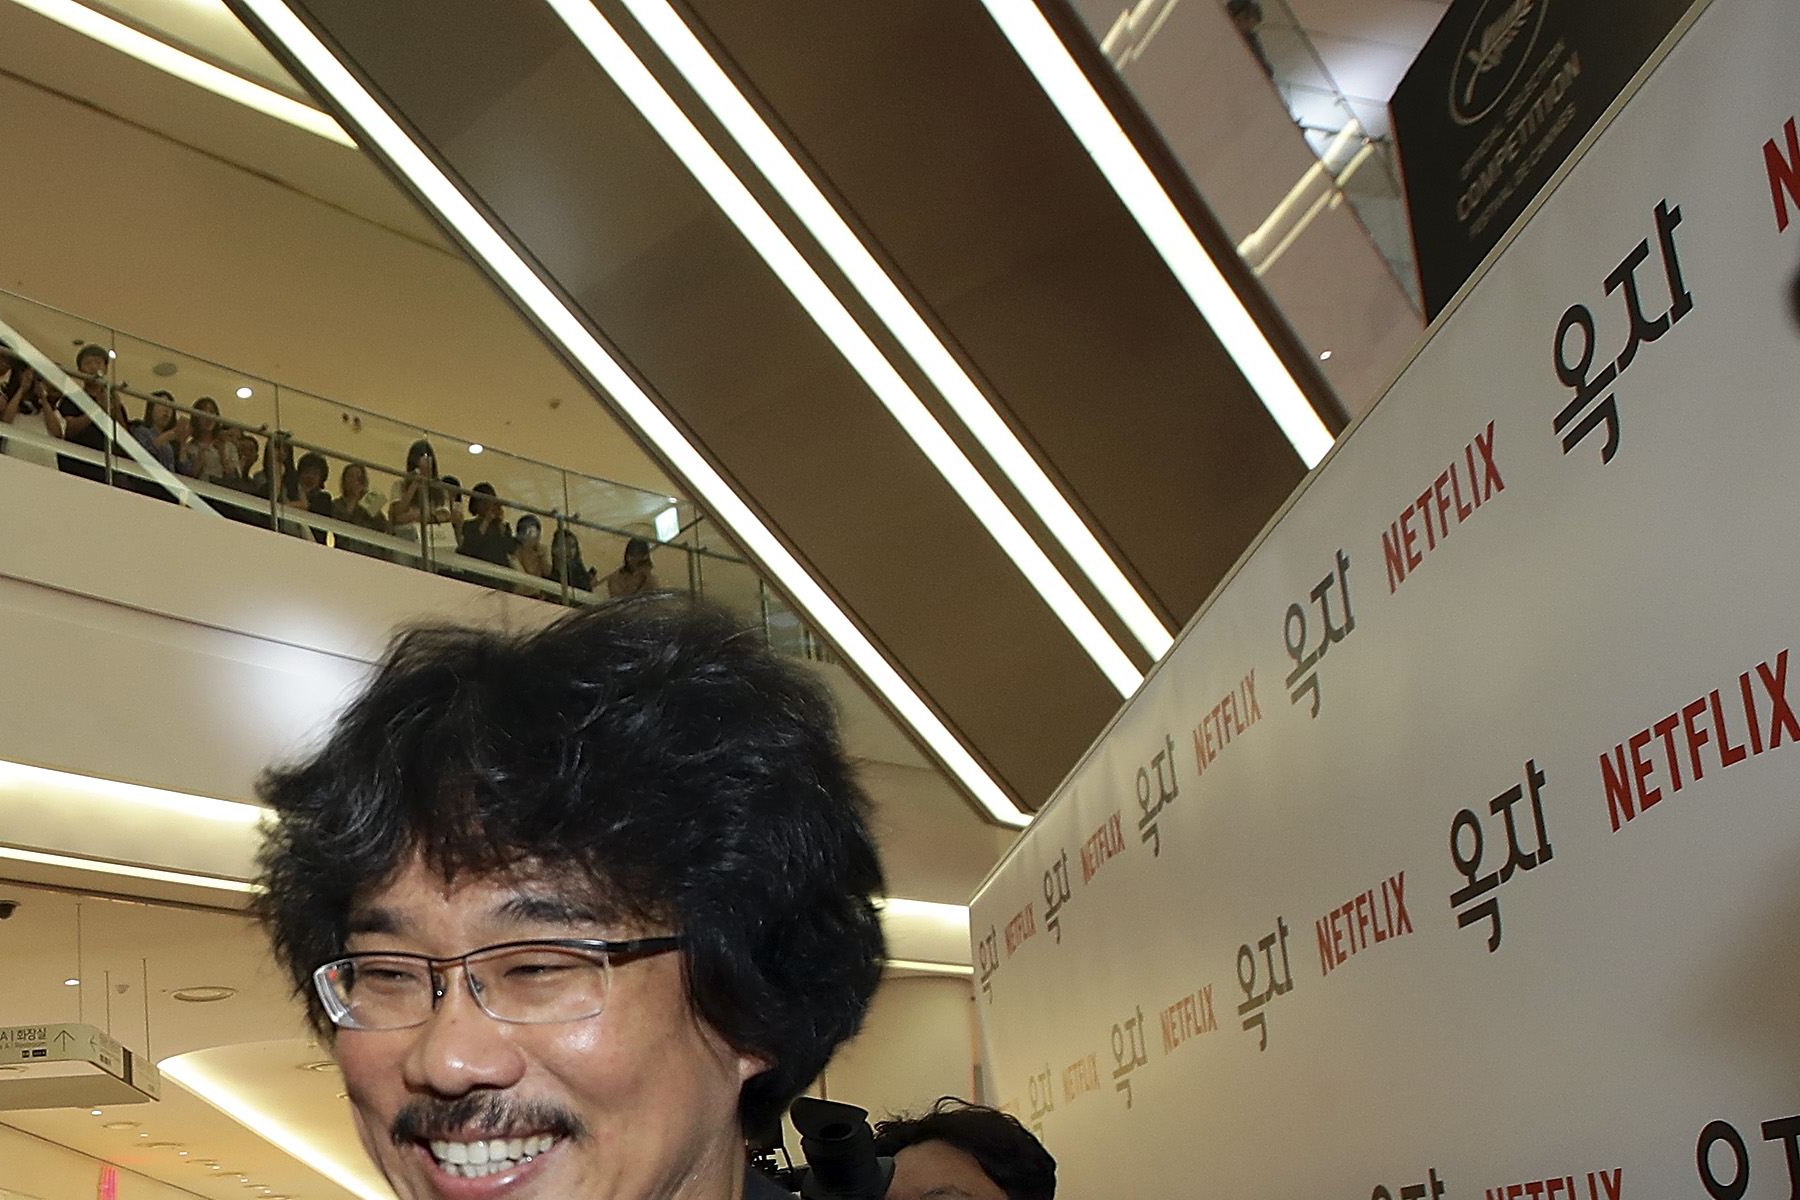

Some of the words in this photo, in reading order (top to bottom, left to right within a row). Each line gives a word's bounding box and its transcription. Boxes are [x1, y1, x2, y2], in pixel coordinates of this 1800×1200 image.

[1043, 849, 1071, 944] 옥자
[1079, 810, 1125, 884] NETFLIX
[1136, 734, 1178, 857] 옥자
[1193, 669, 1261, 776] NETFLIX
[1284, 549, 1355, 719] 옥자
[1382, 421, 1505, 594] NETFLIX
[1553, 199, 1693, 464] 옥자
[17, 1027, 46, 1041] 화장실
[1111, 1005, 1147, 1109] 옥자
[1160, 984, 1218, 1054] NETFLIX
[1237, 916, 1293, 1052] 옥자
[1316, 871, 1413, 976] NETFLIX
[1450, 759, 1553, 952] 옥자
[1600, 649, 1800, 832] NETFLIX
